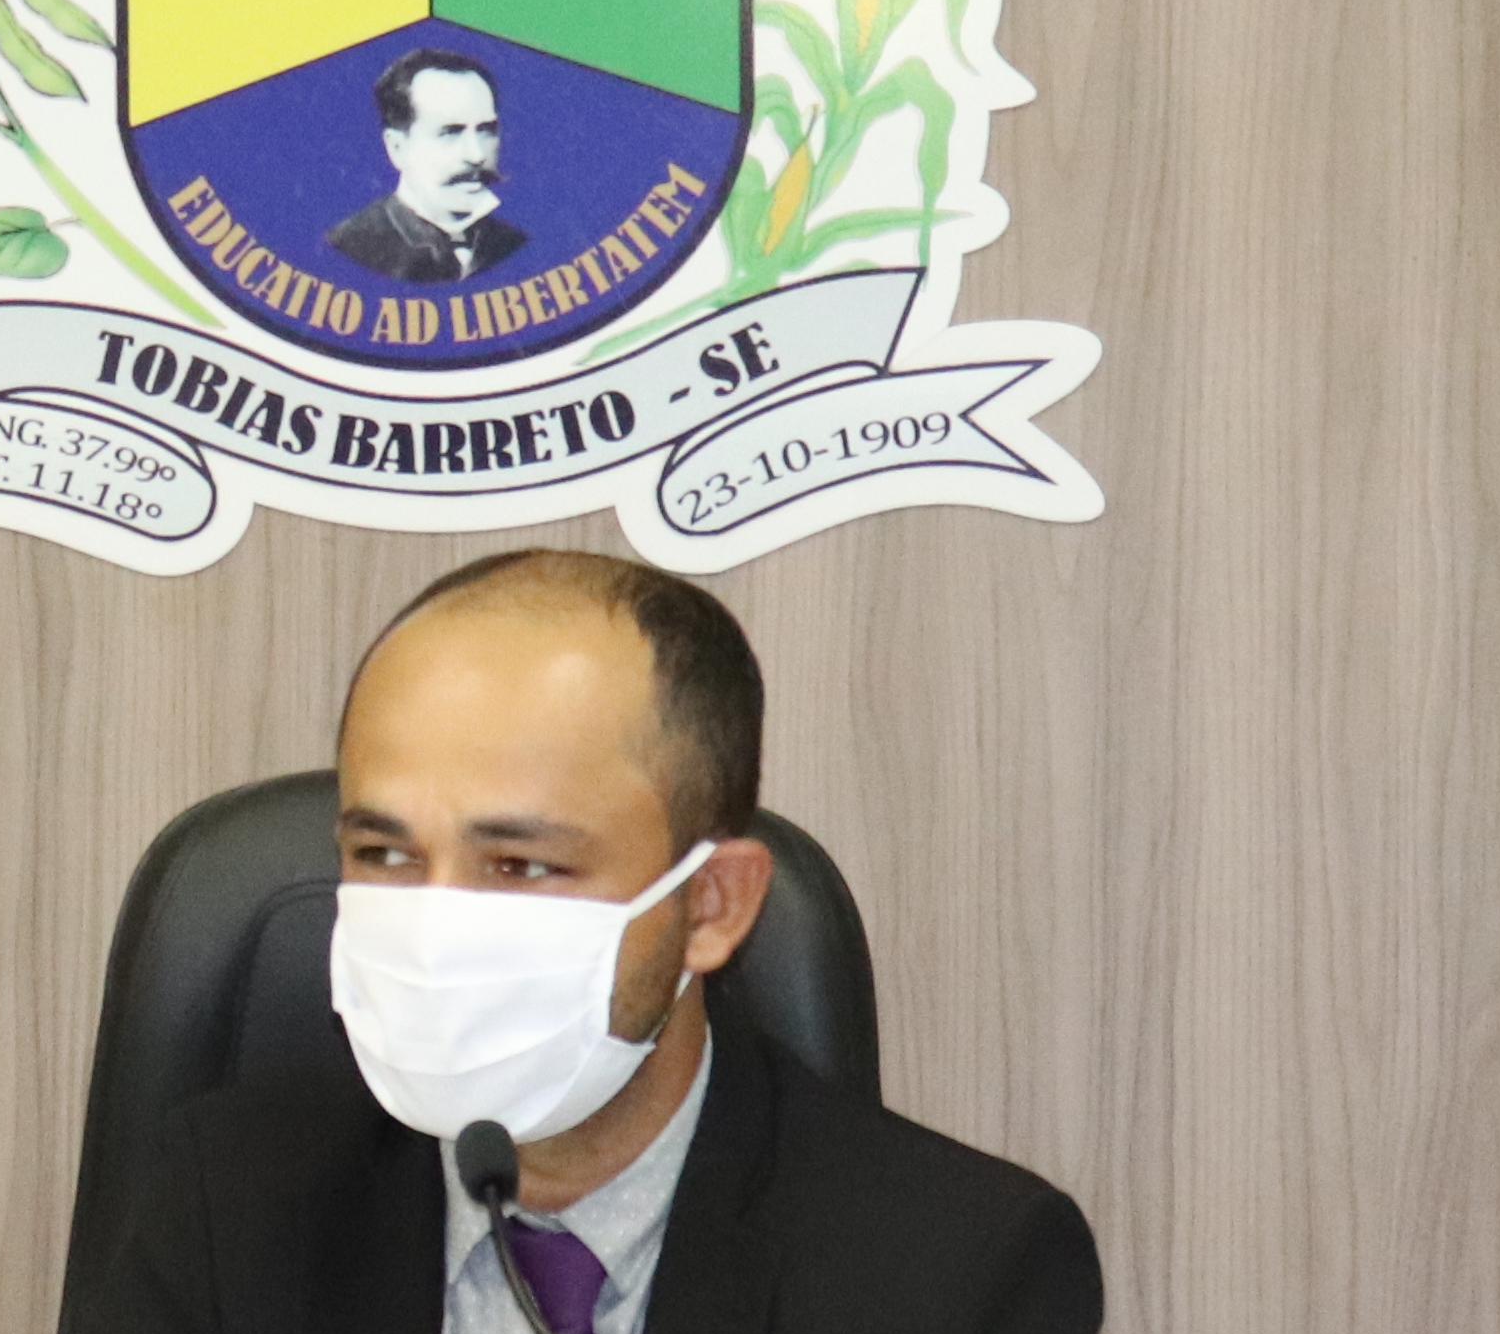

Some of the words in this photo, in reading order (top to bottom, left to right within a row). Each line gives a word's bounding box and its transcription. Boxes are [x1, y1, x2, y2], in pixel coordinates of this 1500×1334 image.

[167, 174, 363, 337] EDUCATIO
[370, 301, 440, 346] AD
[451, 162, 707, 342] LIBERTATEM
[96, 329, 323, 456] TOBIAS
[331, 389, 636, 475] BARRETO
[678, 412, 951, 525] 23-10-1909
